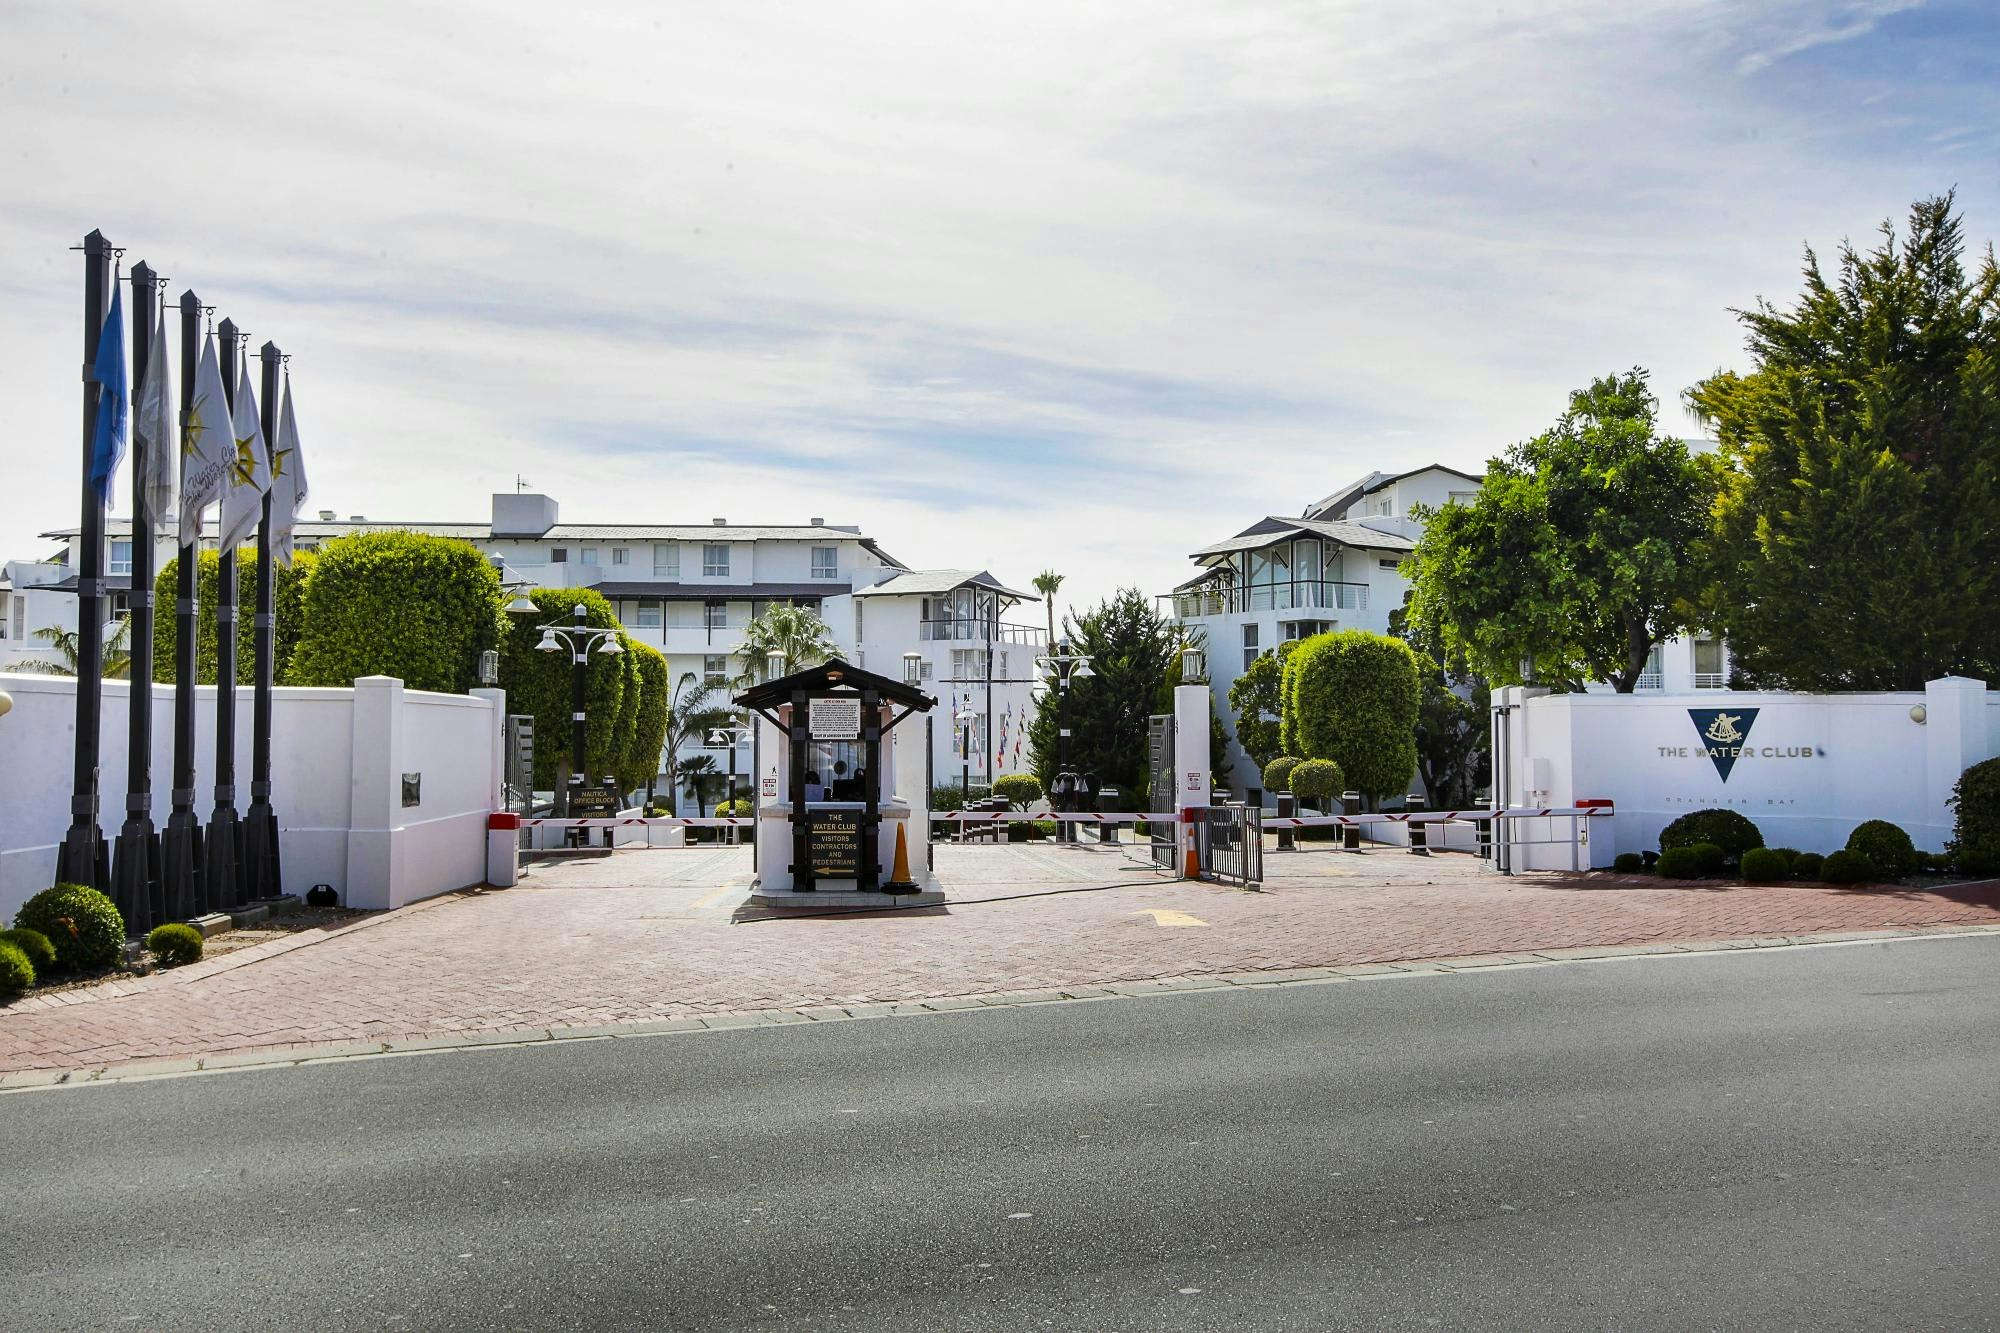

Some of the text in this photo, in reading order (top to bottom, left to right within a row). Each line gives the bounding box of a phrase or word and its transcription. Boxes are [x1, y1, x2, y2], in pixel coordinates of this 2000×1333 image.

[1658, 747, 1813, 758] THE WATER CLUB
